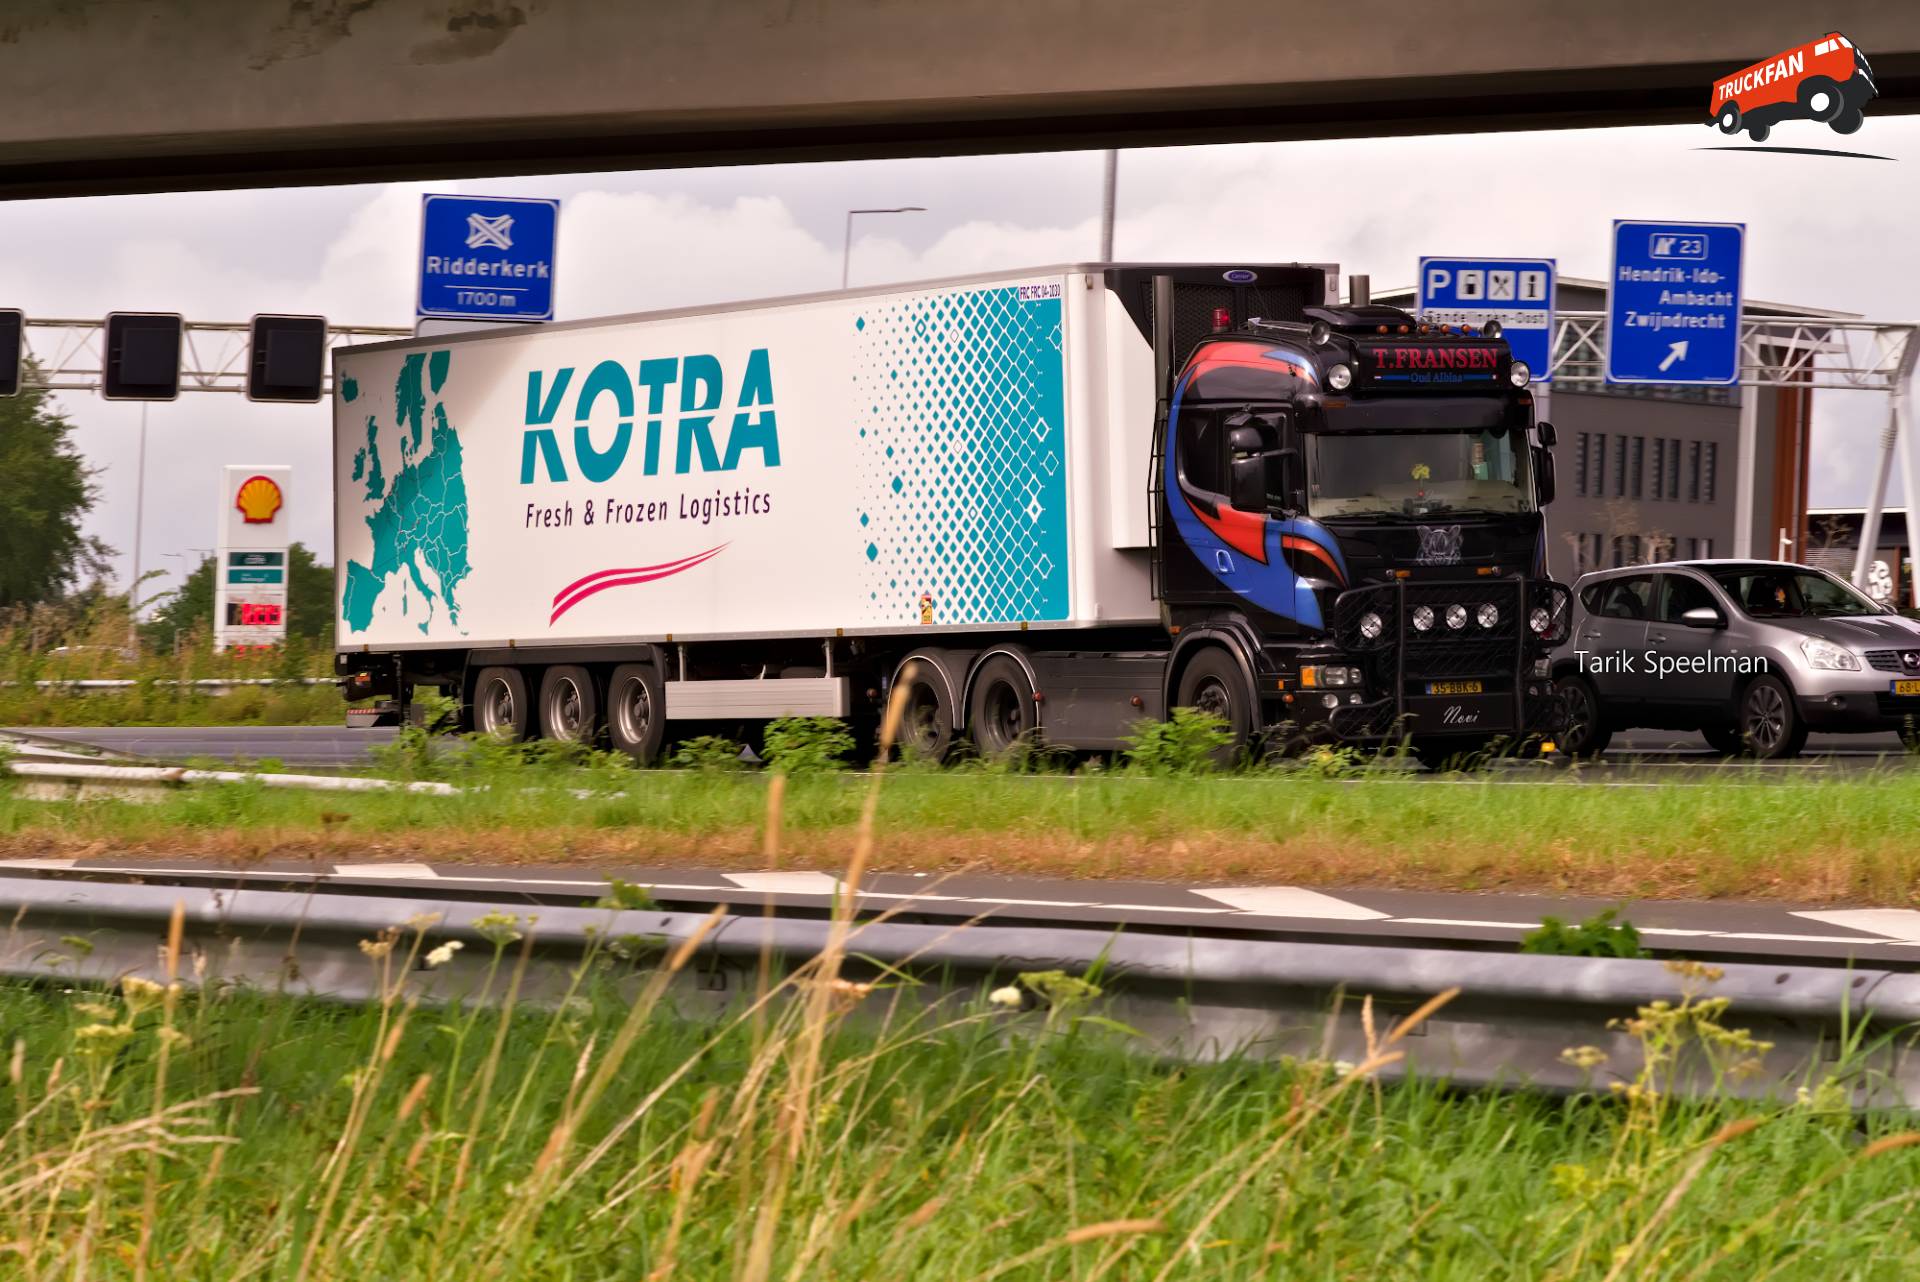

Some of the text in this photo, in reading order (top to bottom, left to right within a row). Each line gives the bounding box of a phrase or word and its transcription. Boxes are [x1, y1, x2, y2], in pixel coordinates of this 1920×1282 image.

[1679, 240, 1702, 254] 23
[426, 256, 549, 278] Ridderkerk
[457, 292, 516, 307] 1700 m
[1658, 290, 1733, 306] Ambacht
[1624, 311, 1726, 332] Zwijndrecht
[520, 348, 781, 483] KOTRA
[526, 487, 771, 528] Fresh & Frozen Logistics
